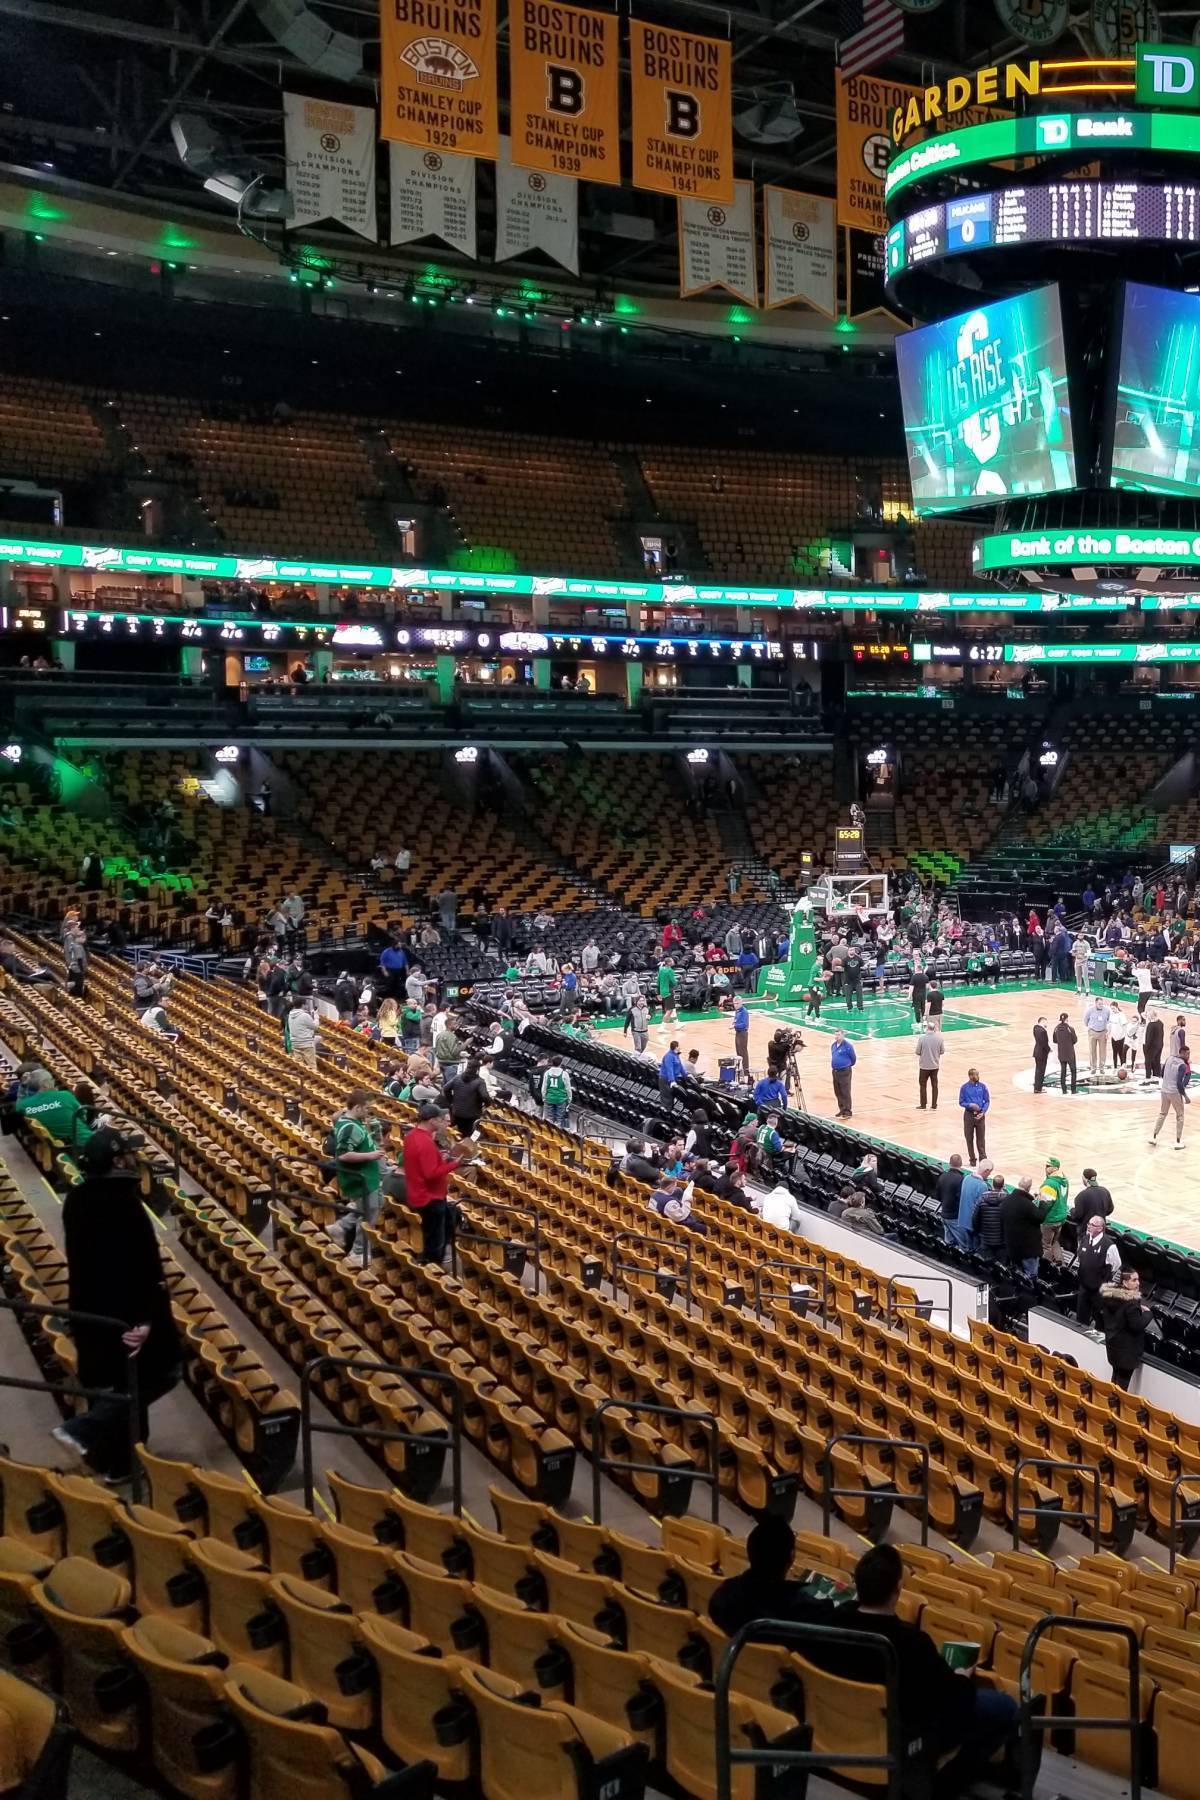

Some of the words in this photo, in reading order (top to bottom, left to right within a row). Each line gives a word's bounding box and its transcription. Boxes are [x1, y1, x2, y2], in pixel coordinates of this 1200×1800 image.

[395, 0, 481, 38] BRUINS
[524, 0, 605, 42] BOSTON
[524, 26, 605, 67] BRUINS
[643, 28, 719, 66] BOSTON
[400, 38, 479, 78] BOSTON
[644, 53, 719, 91] BRUINS
[1143, 54, 1195, 94] TD
[398, 87, 454, 112] STANLEY
[458, 98, 482, 116] CUP
[893, 59, 1040, 142] GARDEN
[396, 104, 484, 134] CHAMPIONS
[526, 114, 578, 138] STANLEY
[582, 125, 604, 142] CUP
[426, 129, 457, 148] 1929
[1039, 119, 1069, 144] TD
[1077, 117, 1133, 138] Bank
[526, 131, 606, 160] CHAMPIONS
[647, 138, 695, 160] STANLEY
[699, 148, 719, 163] CUP
[307, 152, 353, 165] DIVISION
[552, 154, 581, 172] 1939
[646, 154, 721, 181] CHAMPIONS
[301, 161, 361, 176] CHAMPIONS
[411, 170, 454, 183] DIVISION
[405, 179, 462, 194] CHAMPIONS
[671, 176, 698, 193] 1941
[961, 219, 975, 243] 0
[969, 337, 1007, 403] RISE
[0, 545, 23, 556] OUR
[1011, 536, 1052, 558] Bank
[1054, 535, 1075, 556] of
[1078, 534, 1112, 555] the
[1116, 535, 1190, 556] Boston
[126, 554, 153, 566] OBEY
[156, 557, 183, 568] YOUR
[185, 559, 218, 571] THIRST
[279, 566, 308, 577] OBEY
[310, 568, 337, 578] YOUR
[339, 569, 373, 580] THIRST
[431, 575, 457, 585] OBEY
[459, 577, 484, 587] YOUR
[485, 578, 517, 588] THIRST
[569, 583, 593, 593] OBEY
[594, 585, 618, 594] YOUR
[619, 586, 648, 596] THIRST
[75, 621, 86, 632] 2
[102, 622, 112, 633] 4
[129, 624, 138, 634] 1
[155, 625, 164, 635] 1
[181, 627, 203, 638] 4/4
[220, 629, 244, 640] 4/6
[263, 630, 279, 641] 67
[153, 618, 165, 627] TO
[397, 629, 410, 645] 0
[477, 633, 491, 648] 0
[621, 645, 640, 655] 3/4
[655, 645, 675, 656] 2/2
[933, 645, 961, 657] Bank
[969, 645, 1004, 660] 6:27
[222, 745, 239, 759] 10
[461, 747, 478, 759] 10
[693, 748, 709, 759] 10
[873, 749, 888, 761] 10
[1045, 751, 1059, 763] 10
[839, 830, 860, 839] 65:28
[24, 1099, 62, 1117] Reebok
